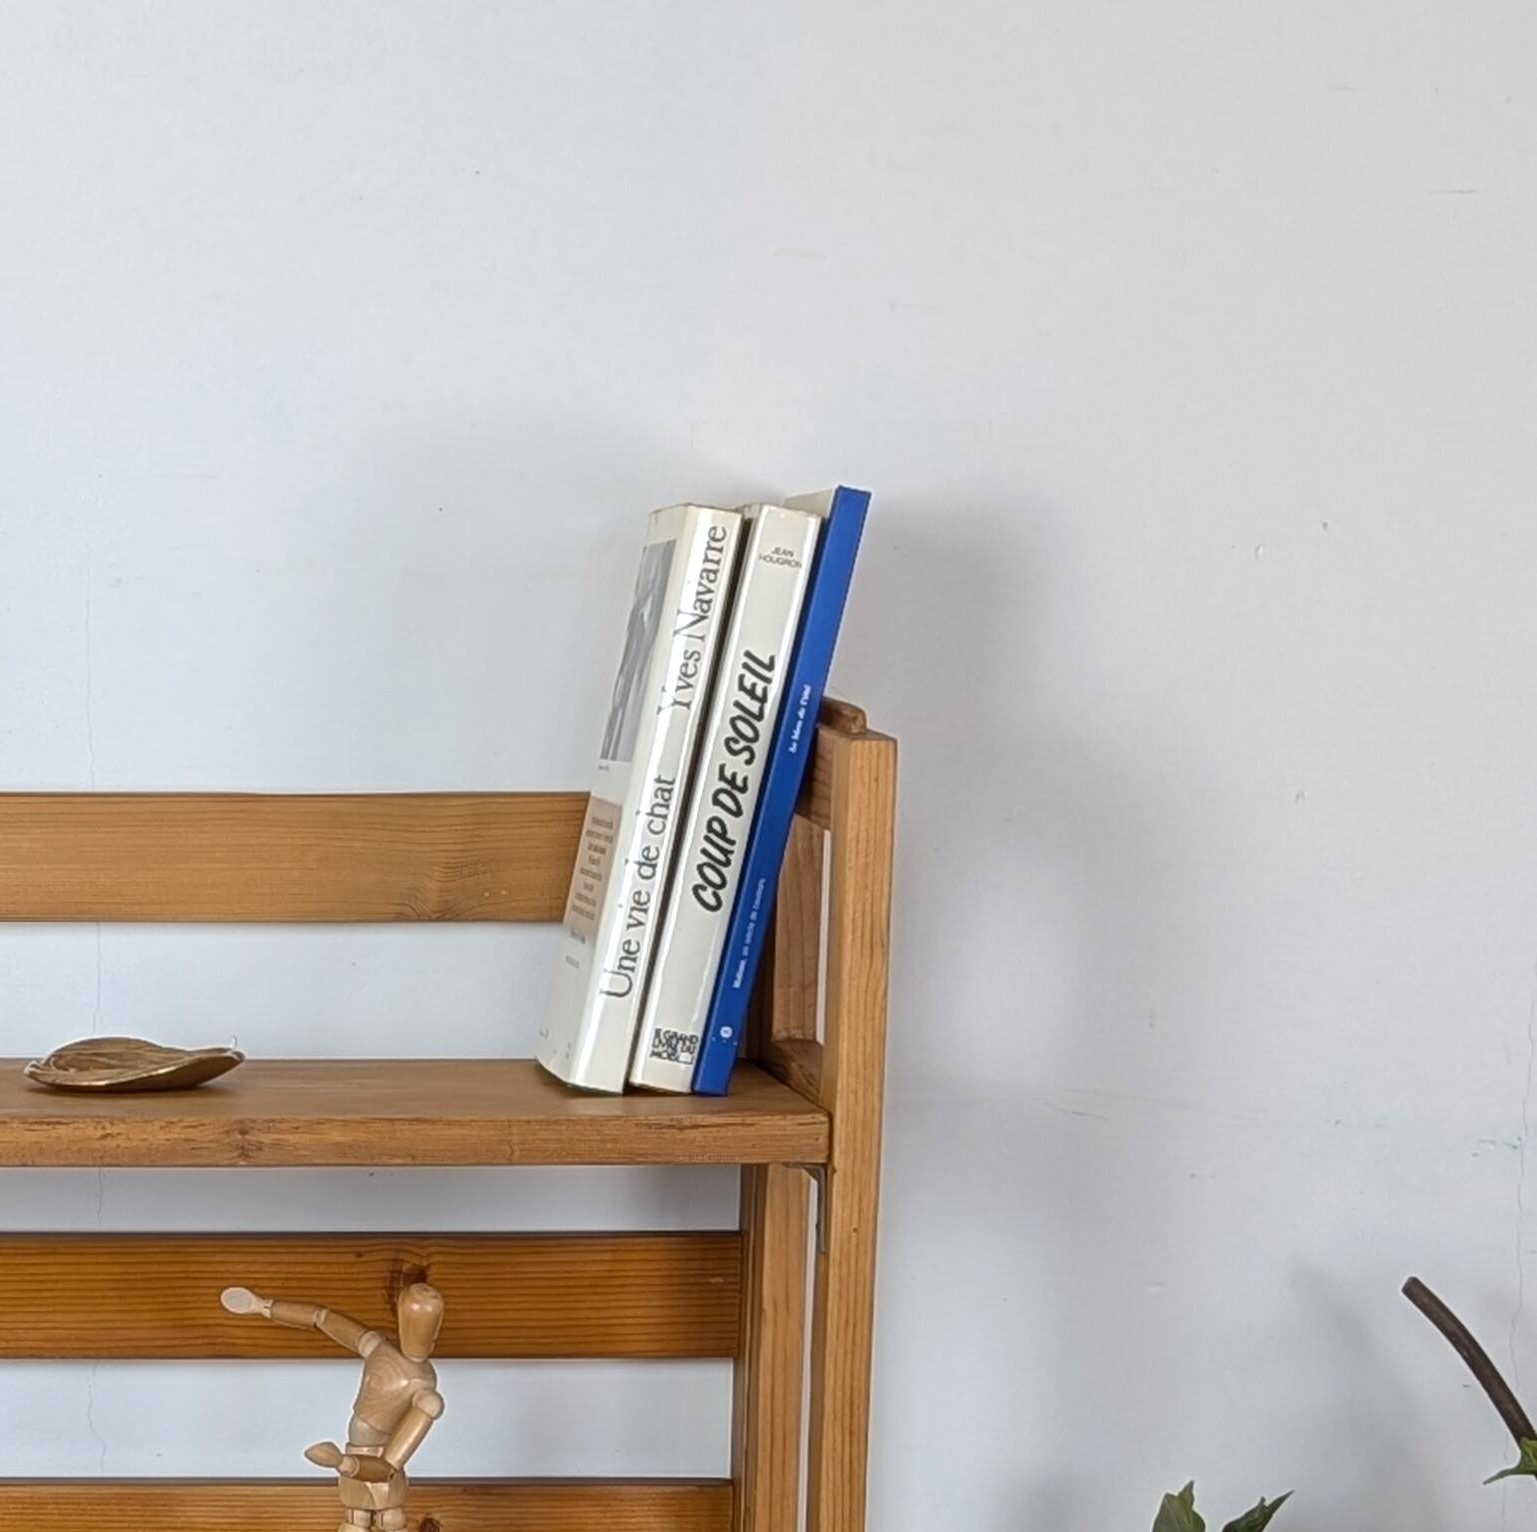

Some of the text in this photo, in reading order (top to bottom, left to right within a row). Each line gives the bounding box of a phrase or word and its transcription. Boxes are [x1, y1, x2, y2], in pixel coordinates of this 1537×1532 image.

[656, 525, 727, 716] Yves Navarre
[599, 774, 676, 998] Une vie de chat
[691, 649, 776, 913] COUP DE SOLEIL
